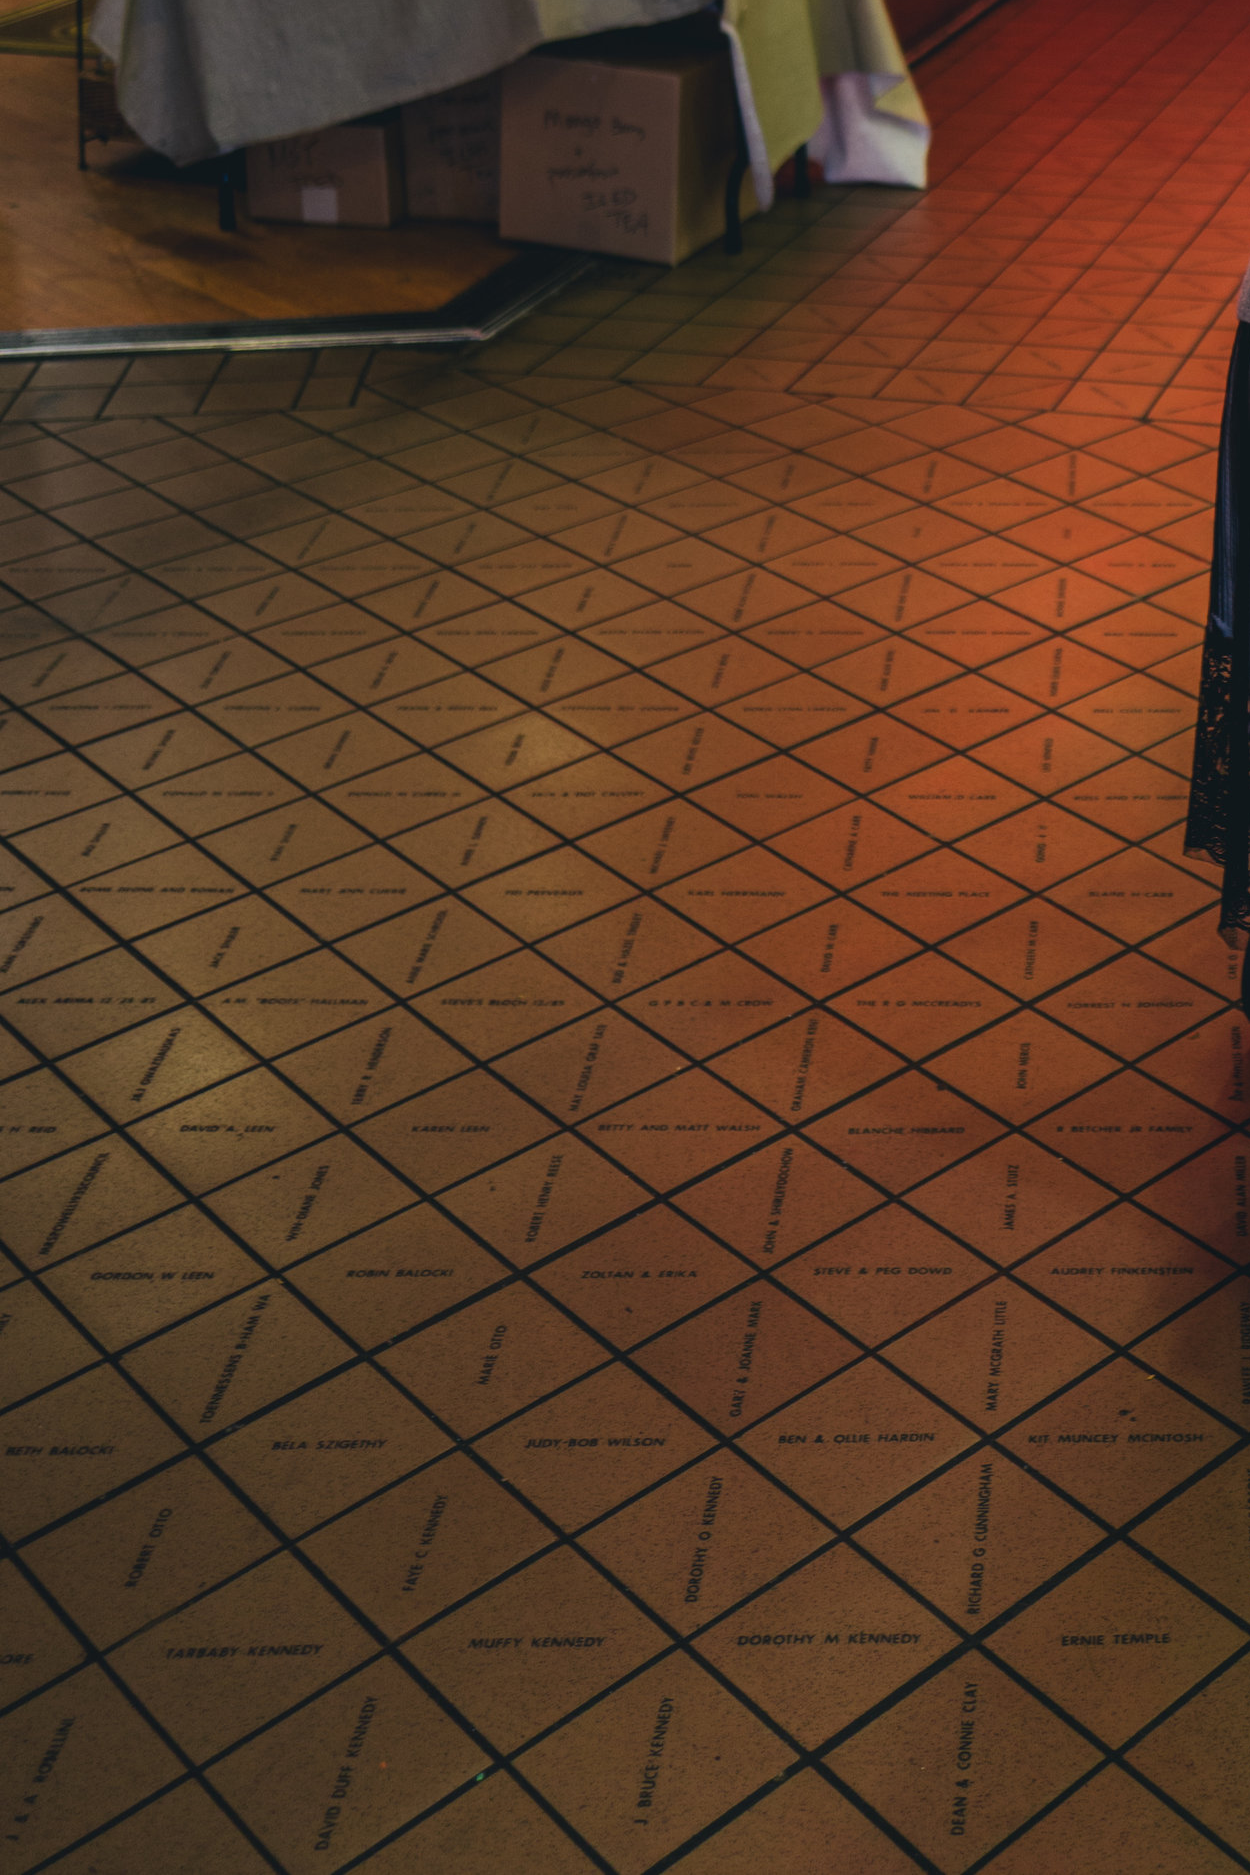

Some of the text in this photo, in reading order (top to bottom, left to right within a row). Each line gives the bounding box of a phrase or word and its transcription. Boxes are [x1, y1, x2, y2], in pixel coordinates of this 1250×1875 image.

[90, 1272, 154, 1281] GORDON
[345, 1269, 390, 1278] ROBIN
[658, 1269, 699, 1279] ERIKA
[813, 1267, 851, 1277] STEVE
[607, 1437, 666, 1448] WILSON
[778, 1434, 806, 1445] BEN
[704, 1475, 724, 1527] KENNEDY
[420, 1493, 448, 1548] KENNEDY
[967, 1558, 985, 1615] RICHARD
[467, 1636, 607, 1650] MUFFY KENNEDY
[737, 1632, 922, 1646] DOROTHY M KENNEDY
[1061, 1633, 1172, 1647] ERNIE TEMPLE
[248, 1643, 325, 1658] KENNEDY
[636, 1762, 661, 1808] BRUCE
[649, 1696, 675, 1758] KENNEDY
[950, 1793, 969, 1837] DEAN
[961, 1680, 981, 1713] CLAY
[314, 1805, 343, 1852] DAVID
[345, 1695, 380, 1759] KENNEDY
